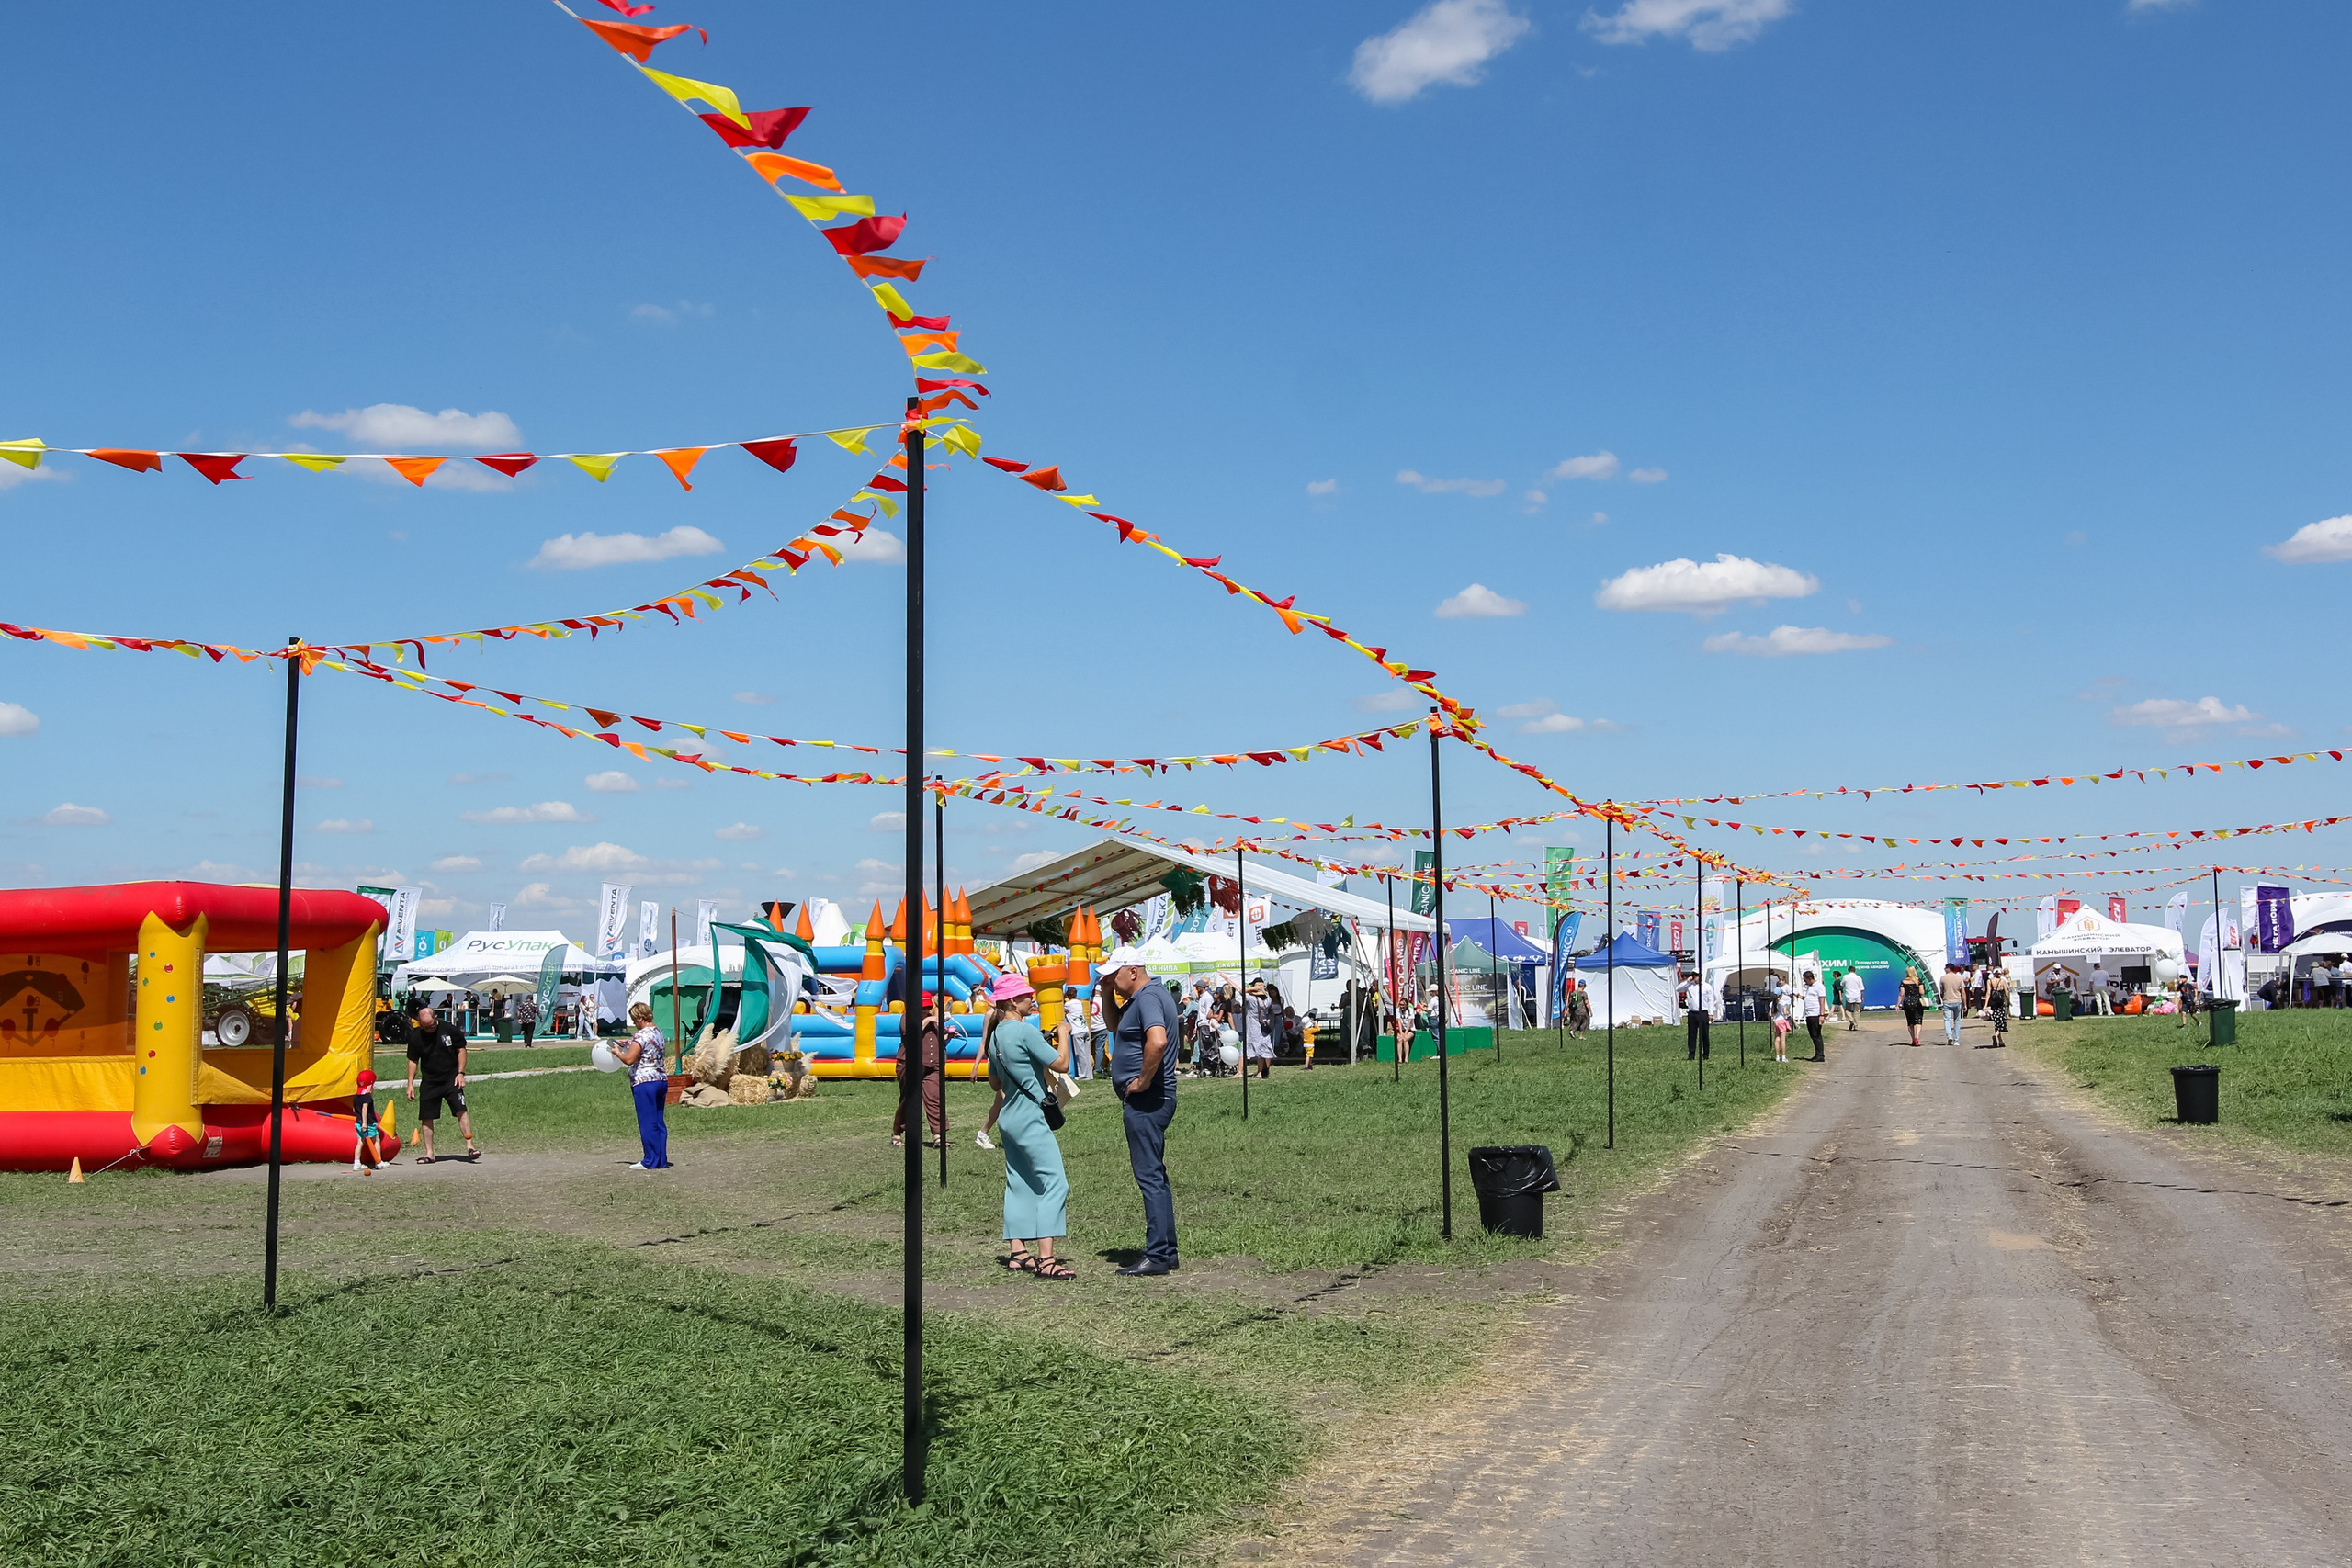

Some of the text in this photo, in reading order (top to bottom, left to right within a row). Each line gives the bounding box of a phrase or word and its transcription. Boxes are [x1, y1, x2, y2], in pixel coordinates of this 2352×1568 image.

[1419, 886, 1430, 916] GANIC
[1154, 895, 1167, 934] ОВСКА
[1189, 914, 1202, 933] ЗОТ
[466, 940, 556, 953] РусУпак
[2036, 946, 2103, 955] КАМЫШИНСКИЙ
[1819, 959, 1848, 967] ХИМ
[538, 962, 556, 1013] РусУпак
